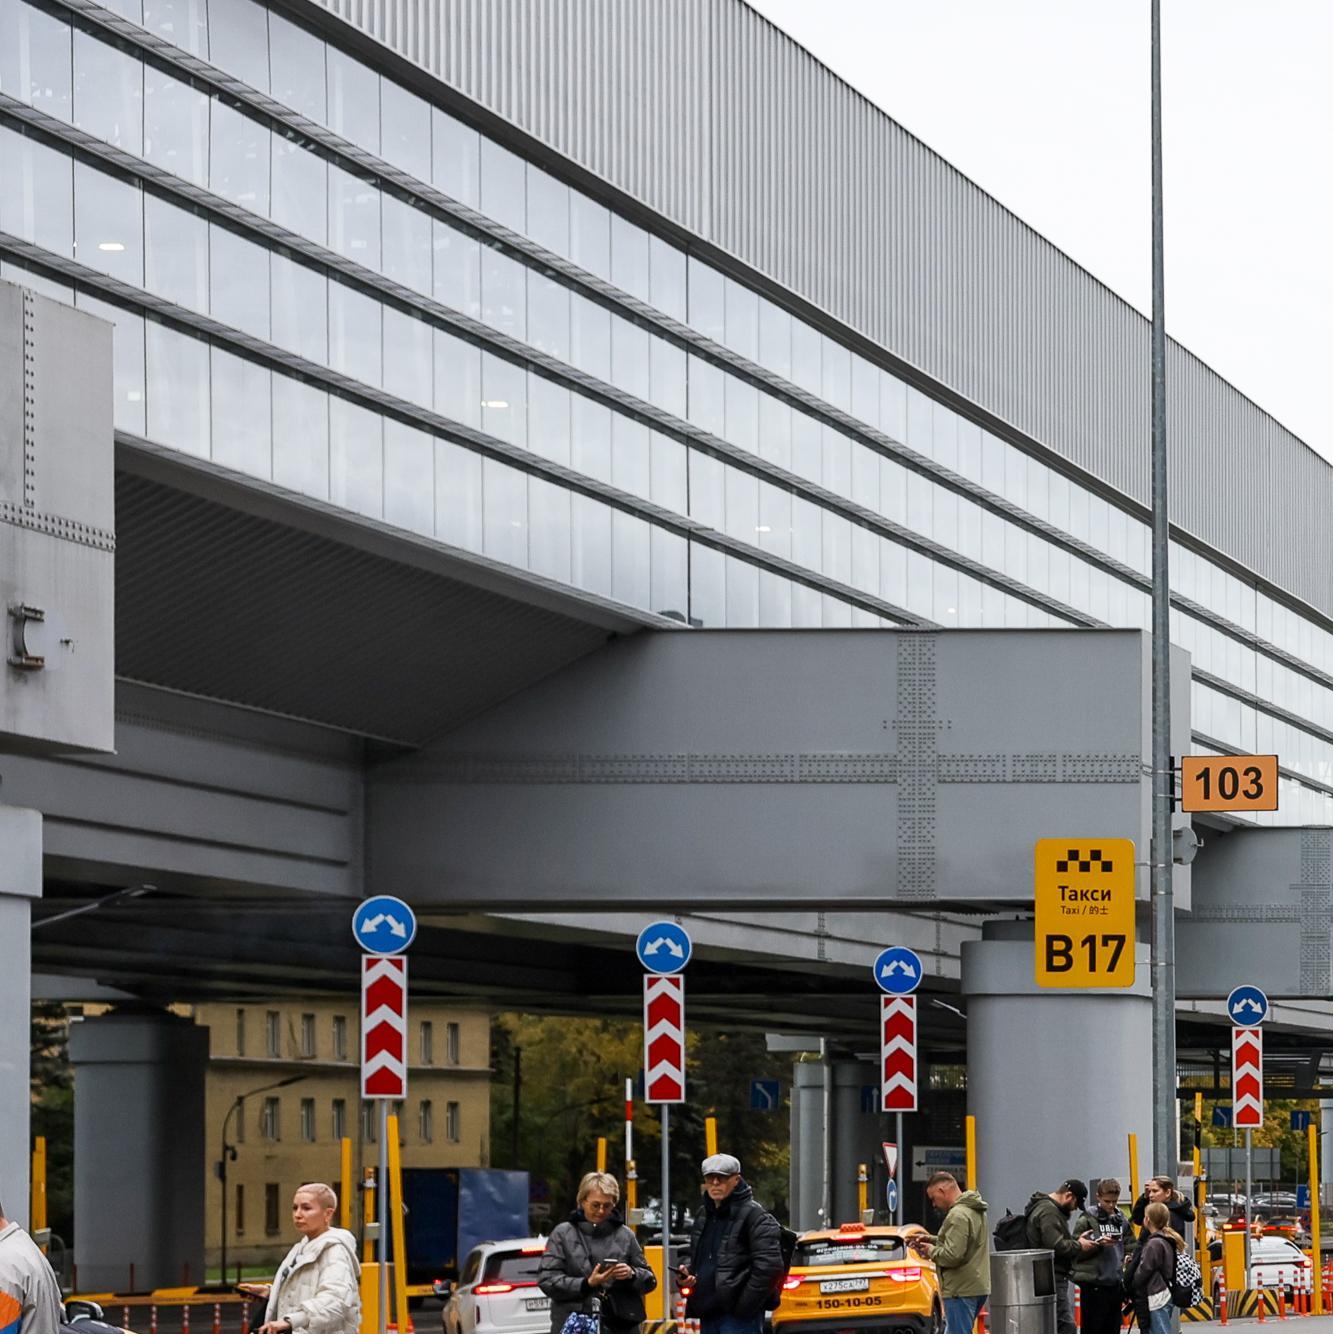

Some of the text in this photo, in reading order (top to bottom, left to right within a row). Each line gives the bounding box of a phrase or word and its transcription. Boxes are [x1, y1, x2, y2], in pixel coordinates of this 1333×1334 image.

[1195, 766, 1264, 801] 103
[1057, 885, 1112, 902] Такси
[1060, 905, 1080, 916] Taxi
[816, 1296, 883, 1310] 150-10-05
